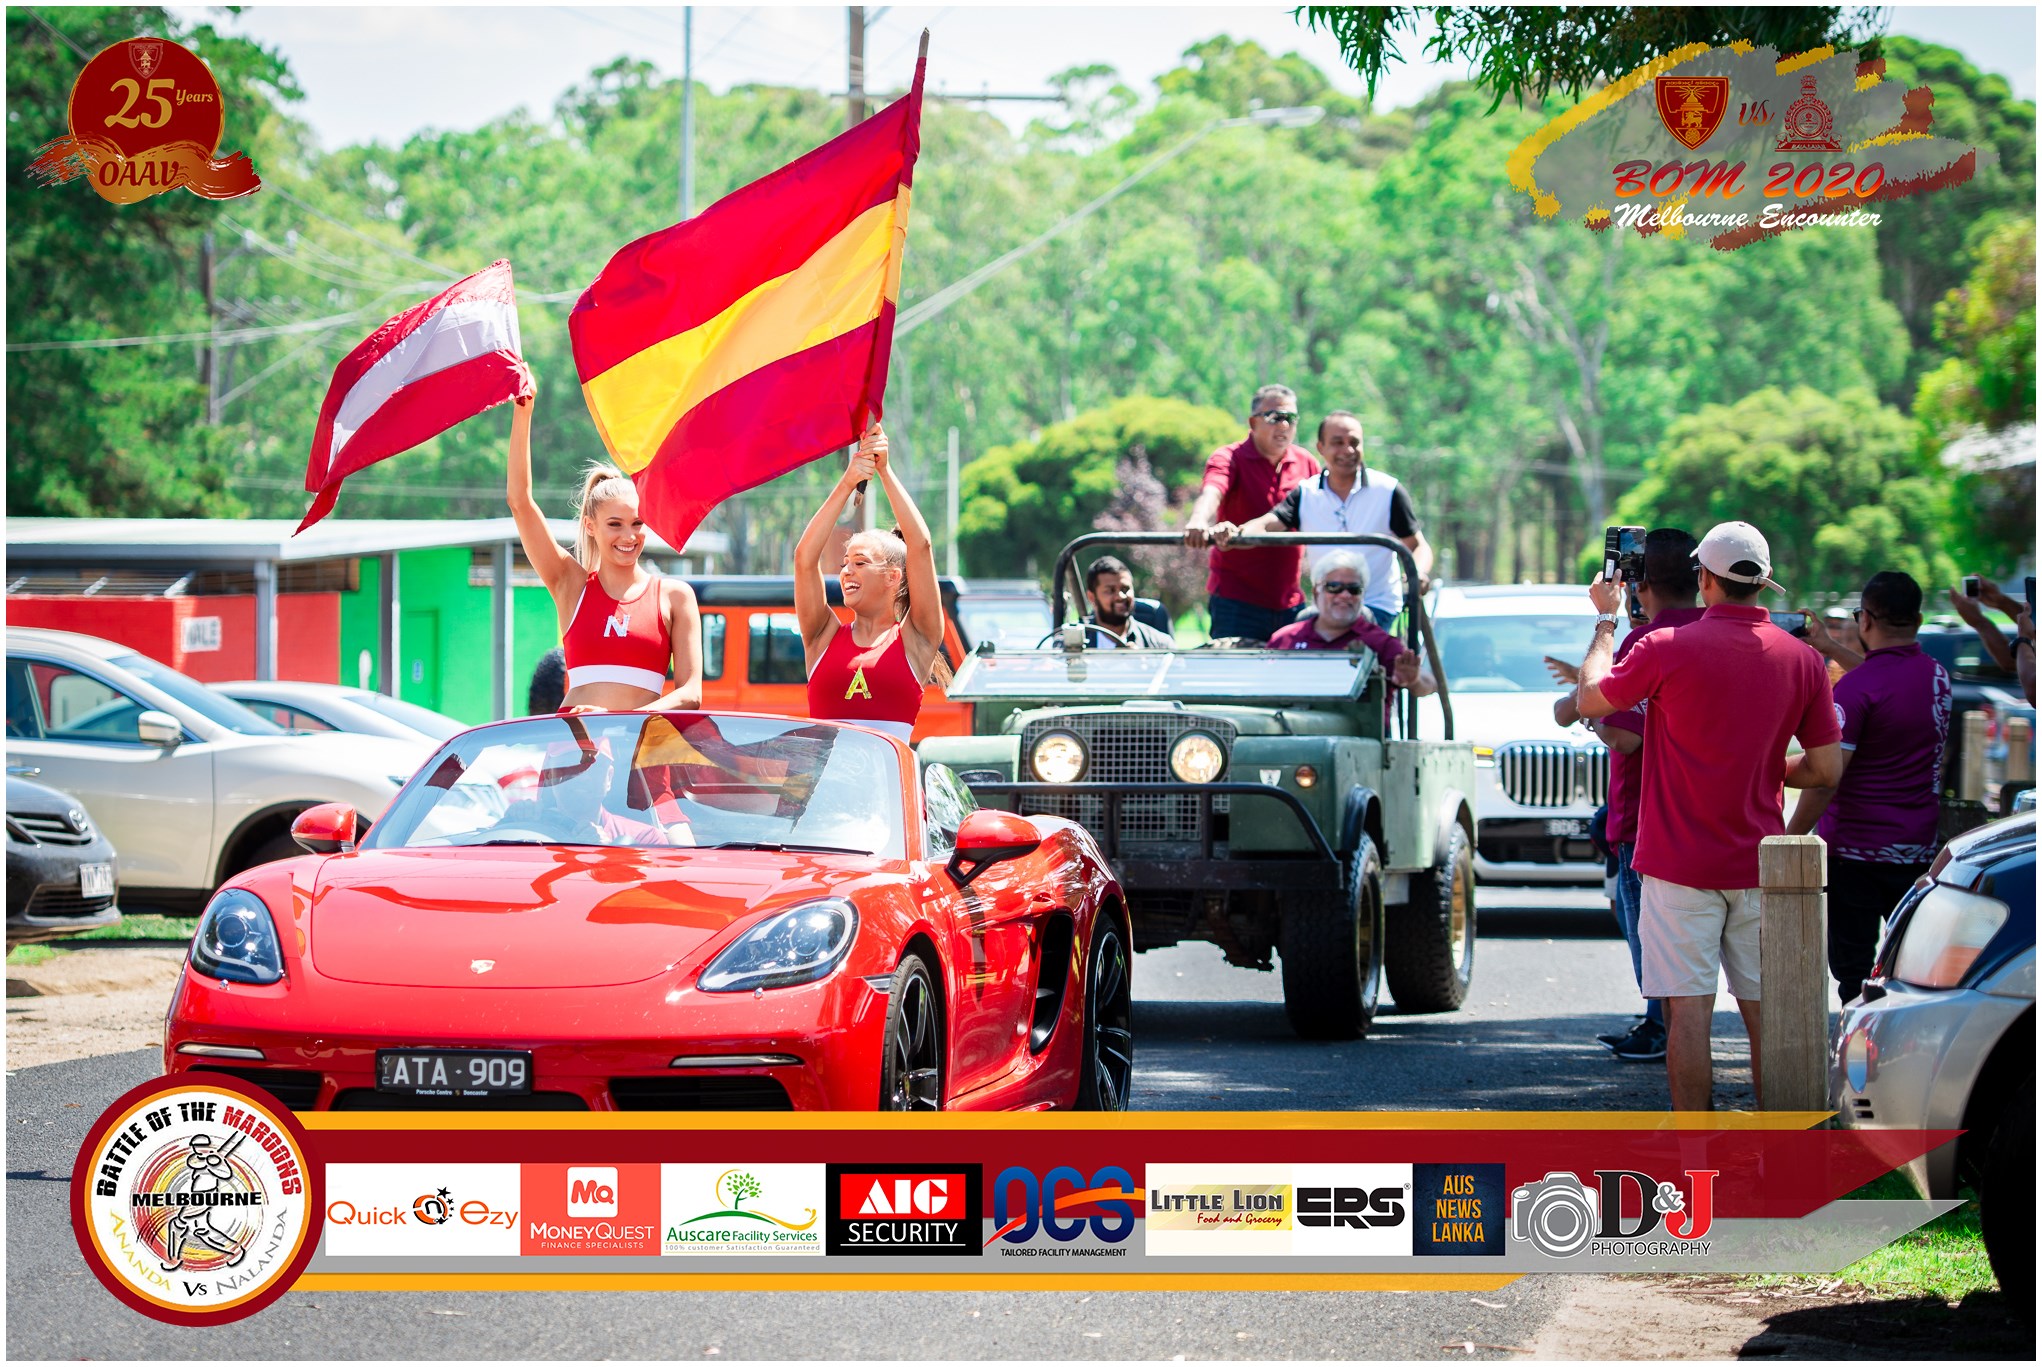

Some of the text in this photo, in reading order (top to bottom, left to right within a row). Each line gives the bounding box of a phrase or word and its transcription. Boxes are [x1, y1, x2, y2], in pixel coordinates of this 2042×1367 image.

[603, 615, 631, 637] N
[844, 667, 872, 700] A
[393, 1057, 526, 1087] ATA 909
